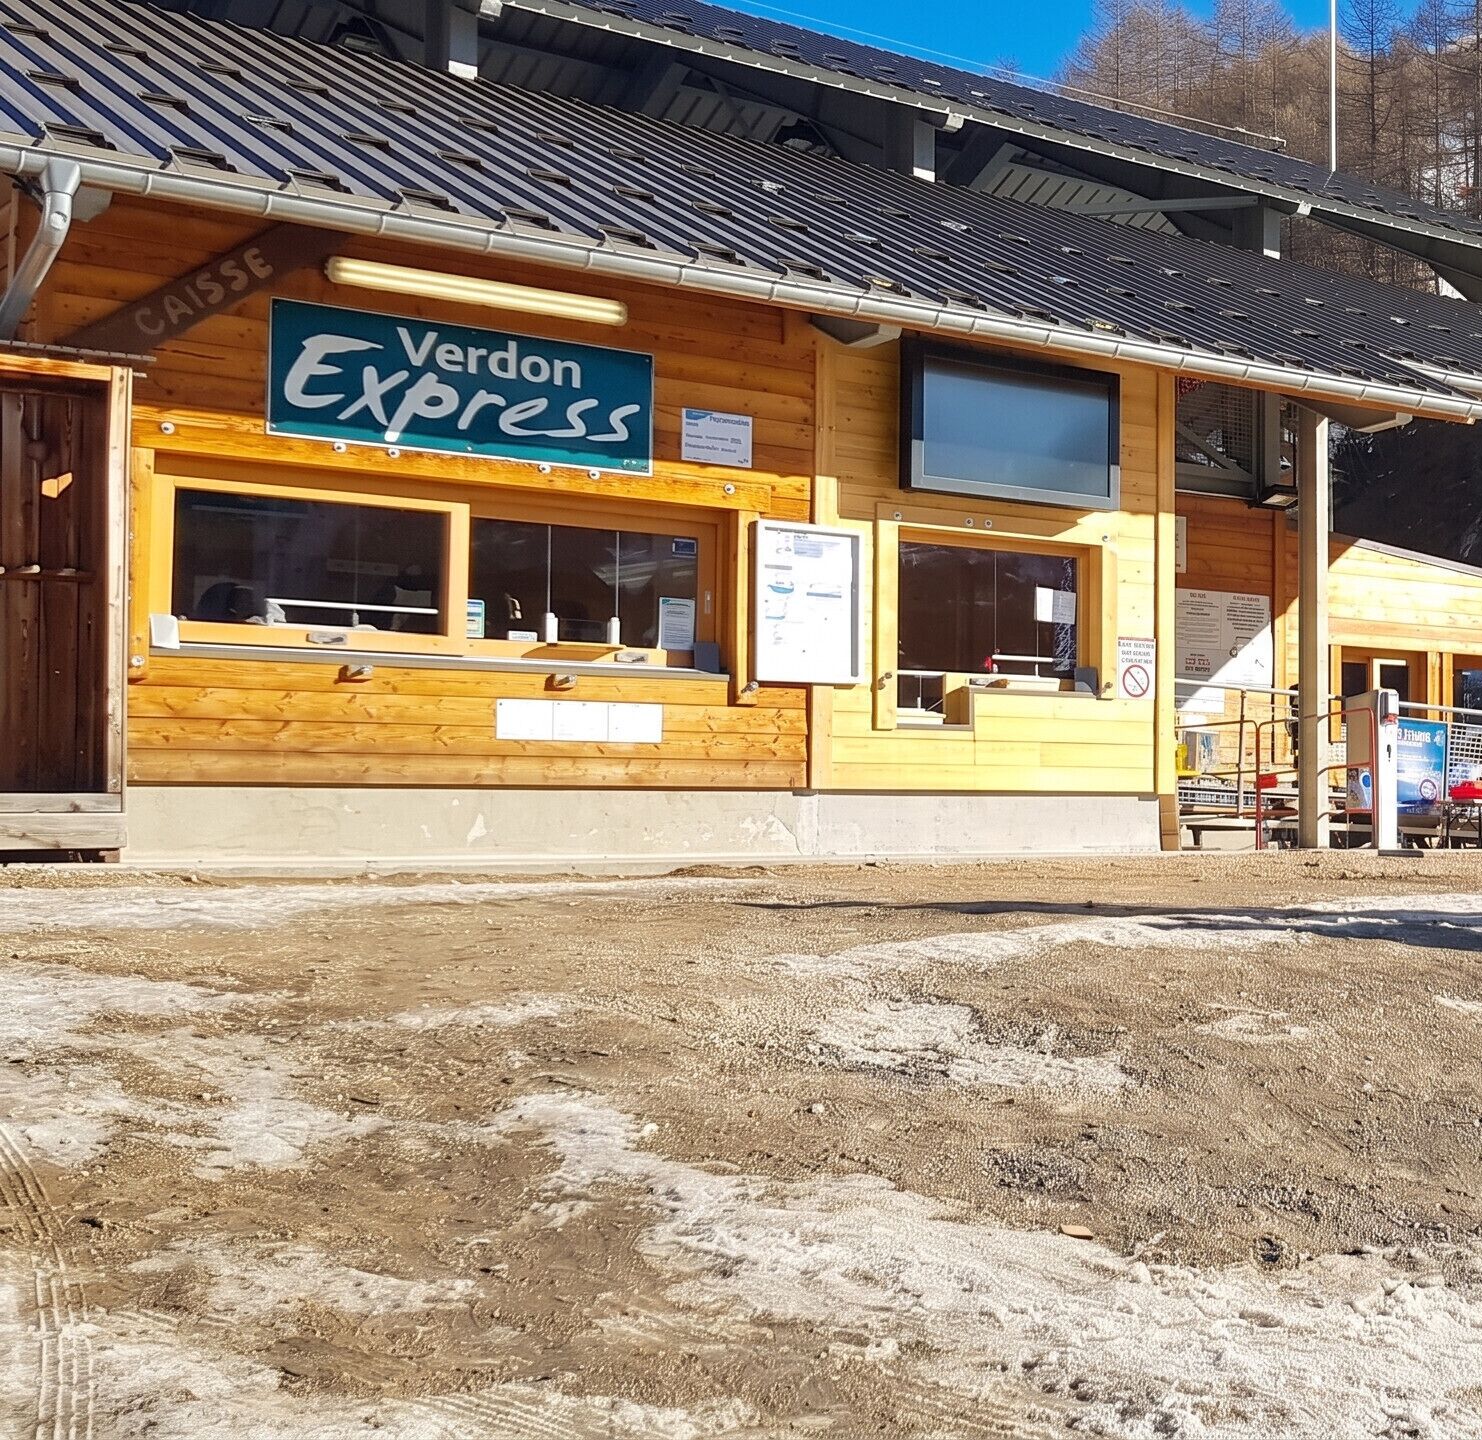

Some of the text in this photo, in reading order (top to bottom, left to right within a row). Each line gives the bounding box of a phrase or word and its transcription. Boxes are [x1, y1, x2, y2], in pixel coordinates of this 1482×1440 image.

[135, 248, 274, 335] CAISSE
[284, 334, 640, 442] Express
[397, 326, 581, 389] Verdon
